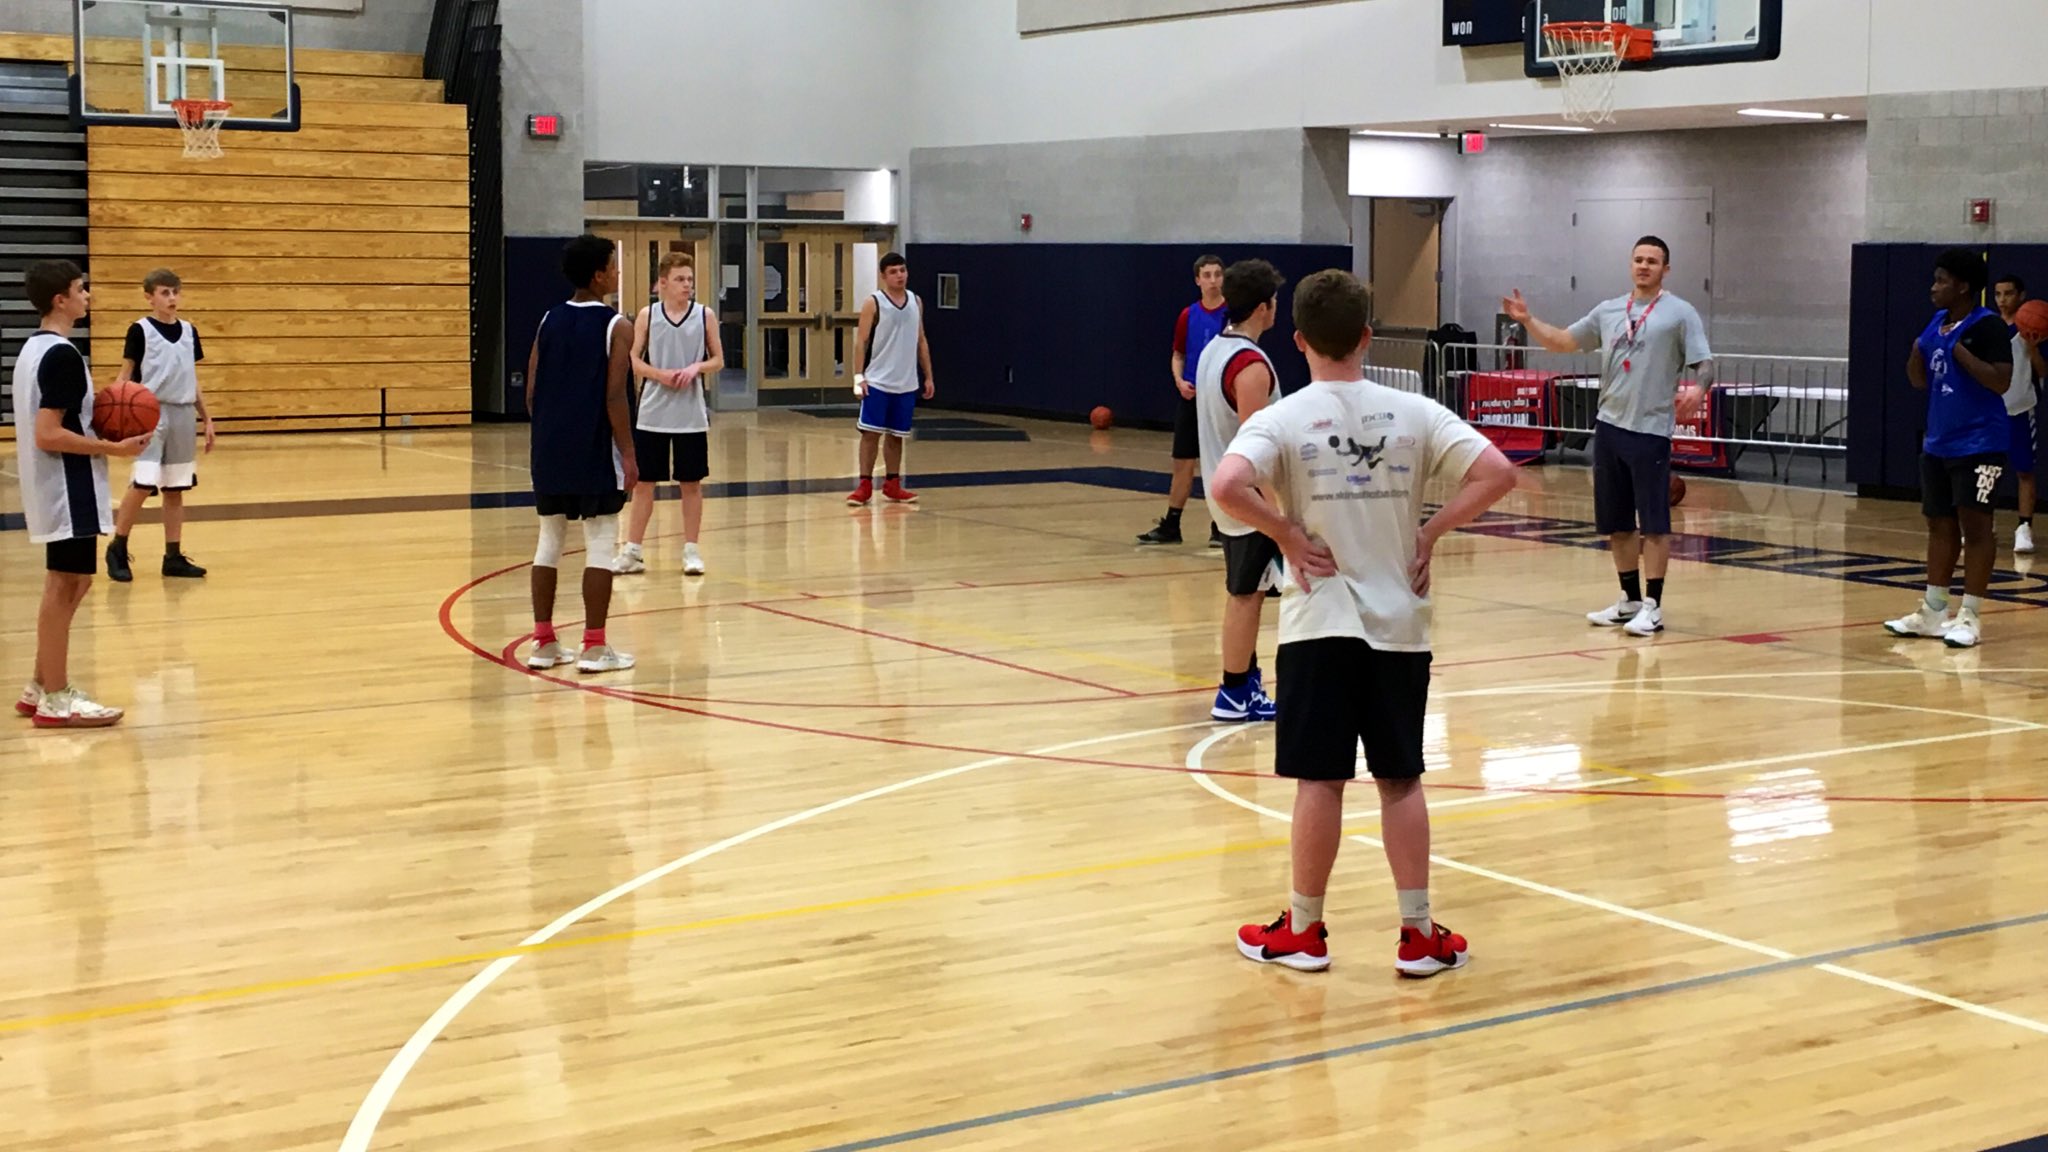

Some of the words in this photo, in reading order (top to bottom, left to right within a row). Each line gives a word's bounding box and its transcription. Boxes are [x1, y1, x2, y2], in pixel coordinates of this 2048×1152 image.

[1452, 20, 1473, 36] won
[1974, 464, 2003, 479] JUST
[1976, 474, 1995, 491] DO
